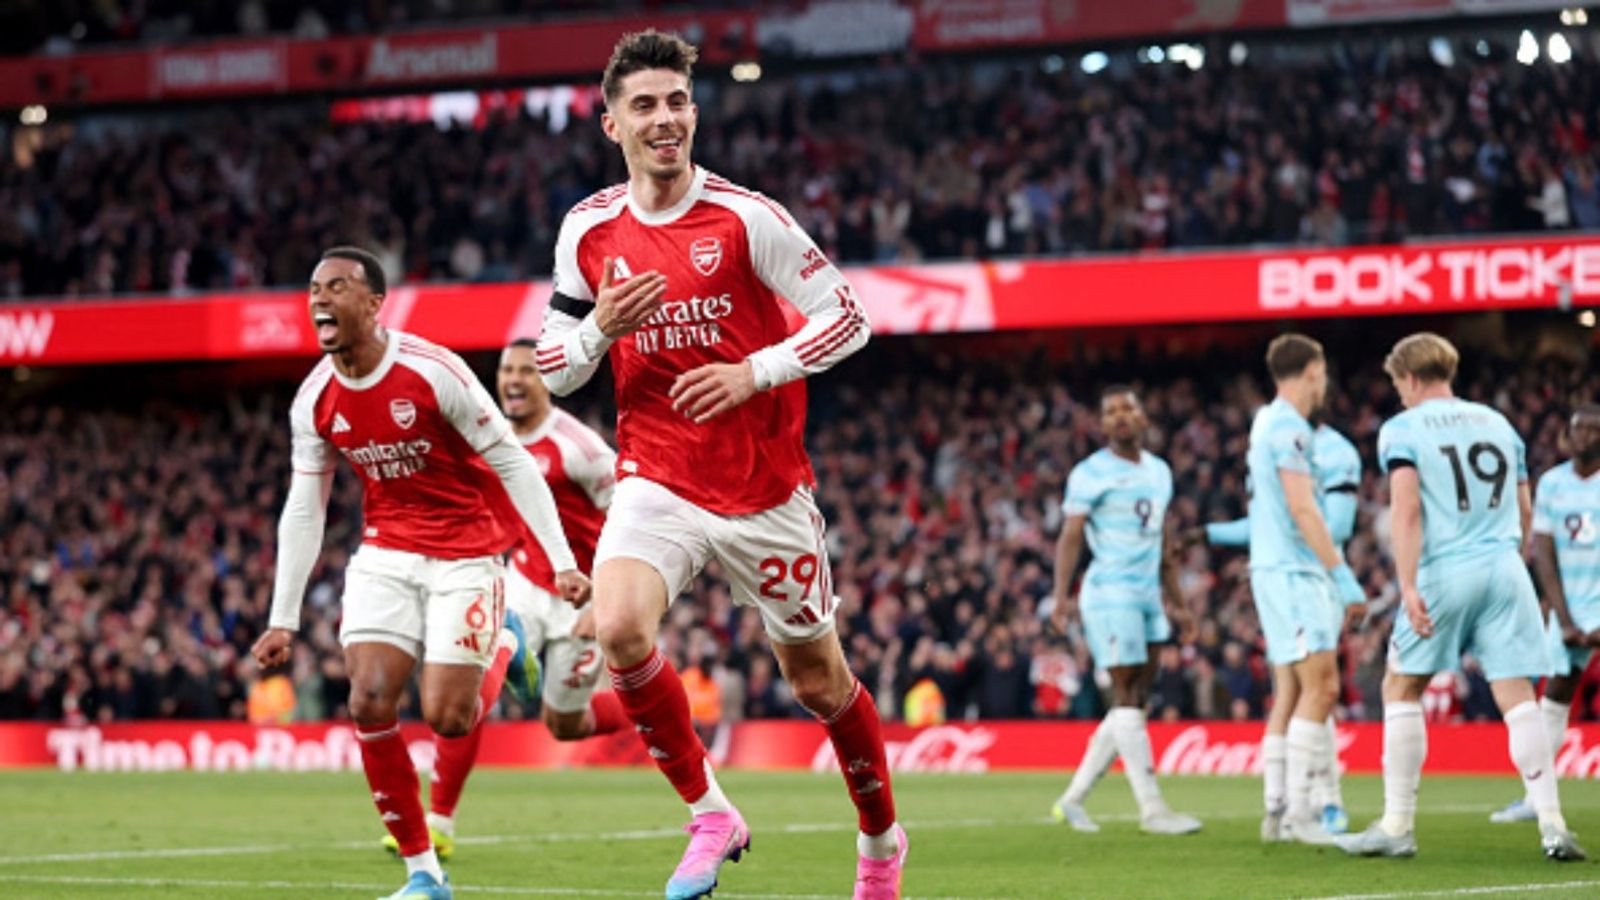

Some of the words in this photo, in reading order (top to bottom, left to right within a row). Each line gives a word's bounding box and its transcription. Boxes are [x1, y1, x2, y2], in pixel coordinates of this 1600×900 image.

[1258, 254, 1433, 311] BOOK
[1438, 246, 1600, 301] TICKE
[0, 312, 54, 357] W
[1439, 442, 1508, 511] 19
[760, 553, 817, 602] 29
[465, 594, 486, 630] 6
[46, 727, 187, 771] Time
[190, 730, 252, 771] to
